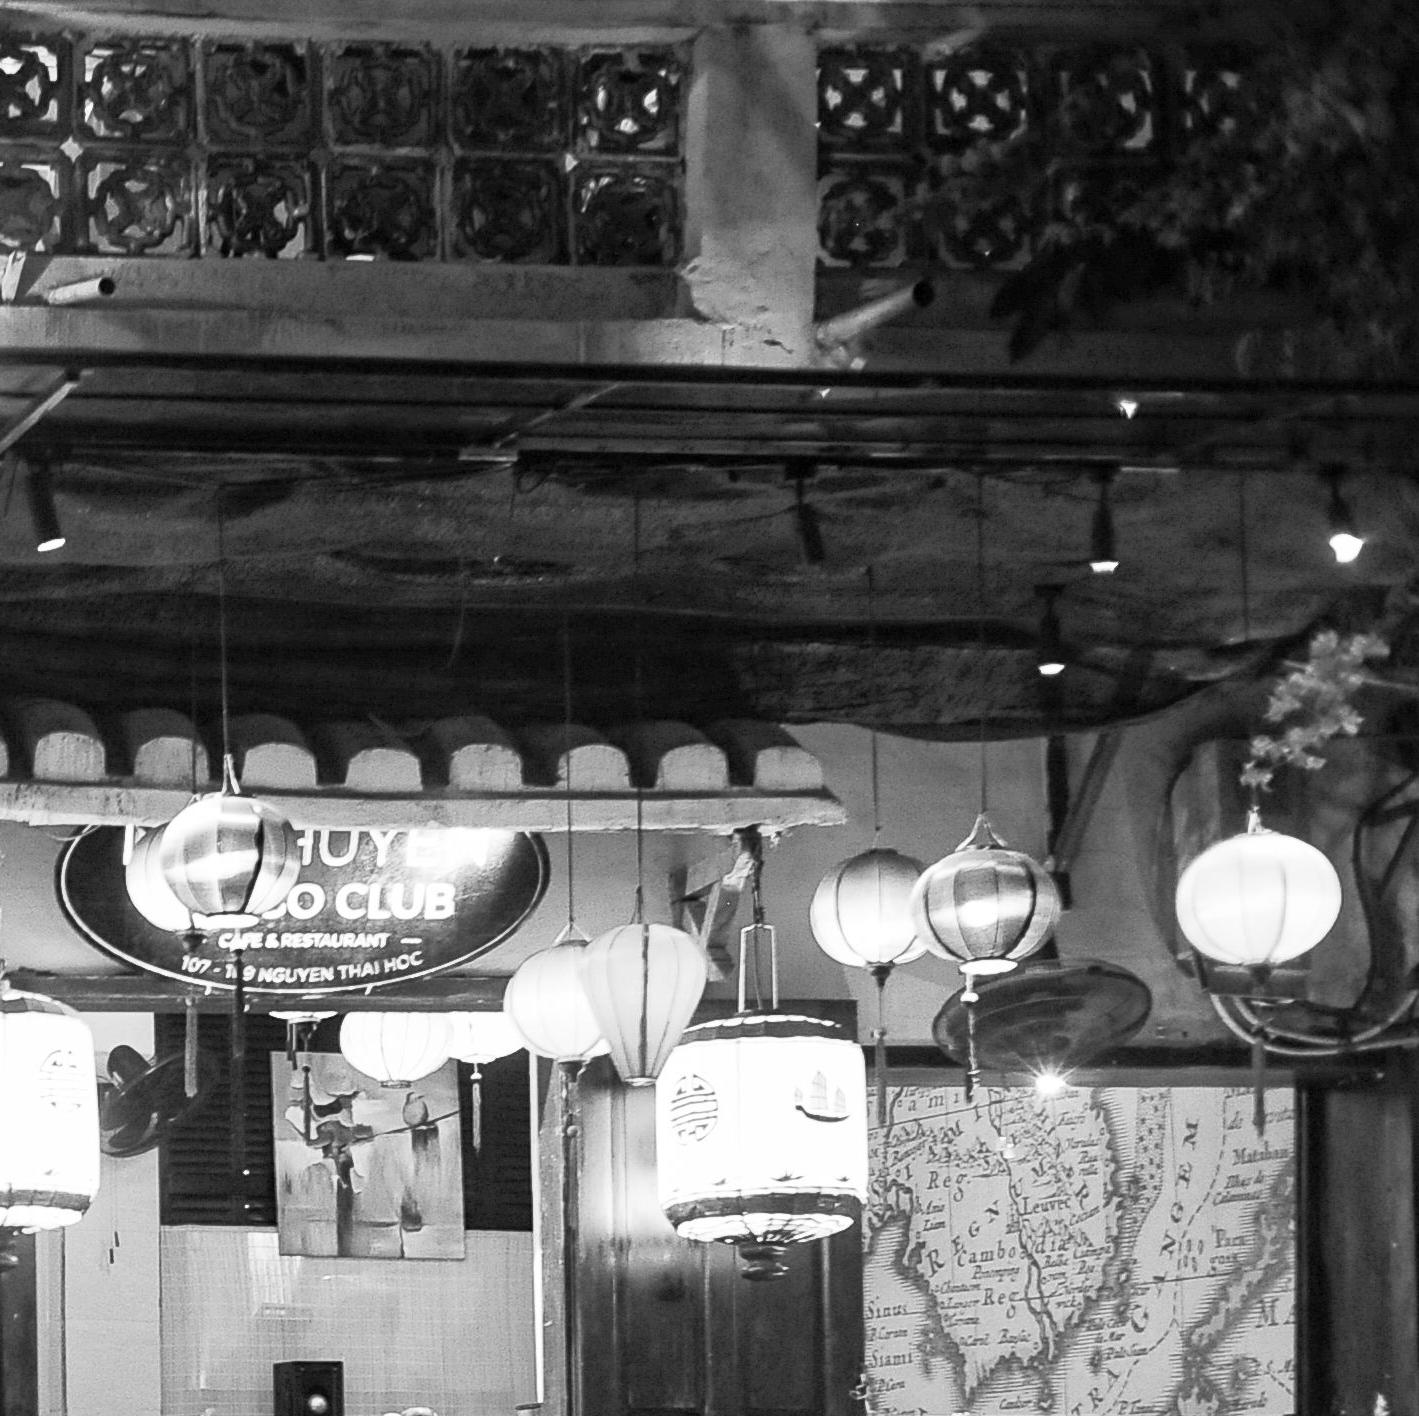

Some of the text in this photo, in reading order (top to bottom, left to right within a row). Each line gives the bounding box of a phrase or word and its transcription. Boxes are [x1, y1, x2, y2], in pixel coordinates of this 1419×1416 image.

[334, 883, 456, 920] CLUB
[280, 932, 391, 949] RESTAURANT
[182, 955, 212, 974] 107
[257, 965, 335, 984] NGUYEN
[337, 961, 380, 980] THAI
[383, 950, 424, 974] HOC
